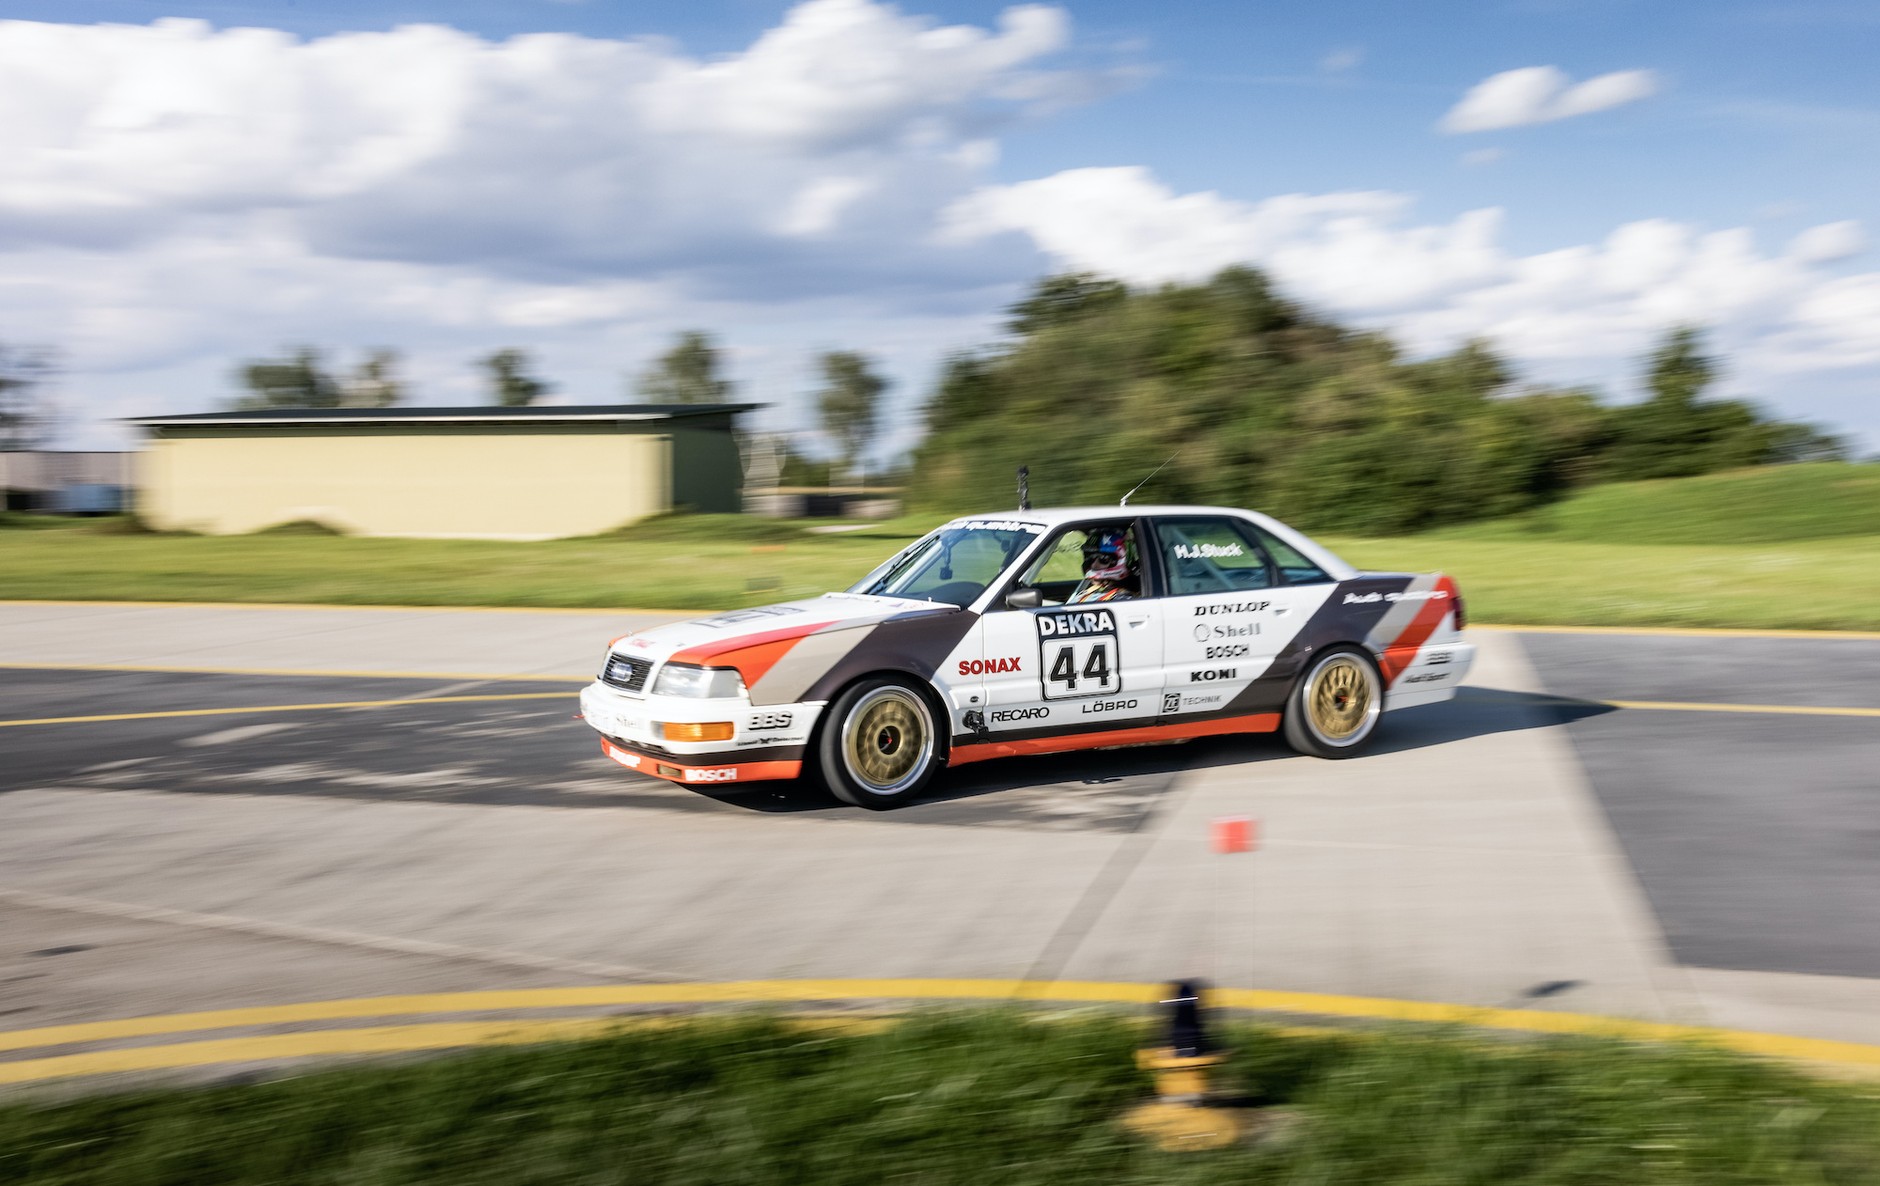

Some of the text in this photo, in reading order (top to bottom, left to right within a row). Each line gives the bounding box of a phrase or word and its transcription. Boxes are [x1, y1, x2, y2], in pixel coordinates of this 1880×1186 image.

[1194, 601, 1270, 617] DUNLOP
[1038, 612, 1115, 636] DEKRA
[1214, 623, 1261, 639] Shell
[1206, 643, 1250, 660] BOSCH
[959, 657, 1021, 675] SONAX
[1049, 643, 1111, 691] 44
[1190, 668, 1236, 682] KONI
[1082, 699, 1138, 715] LÖBRO
[1182, 695, 1222, 706] TECHNIK
[749, 711, 793, 730] BBS
[991, 707, 1049, 723] RECARO
[685, 767, 738, 782] BOSCH
